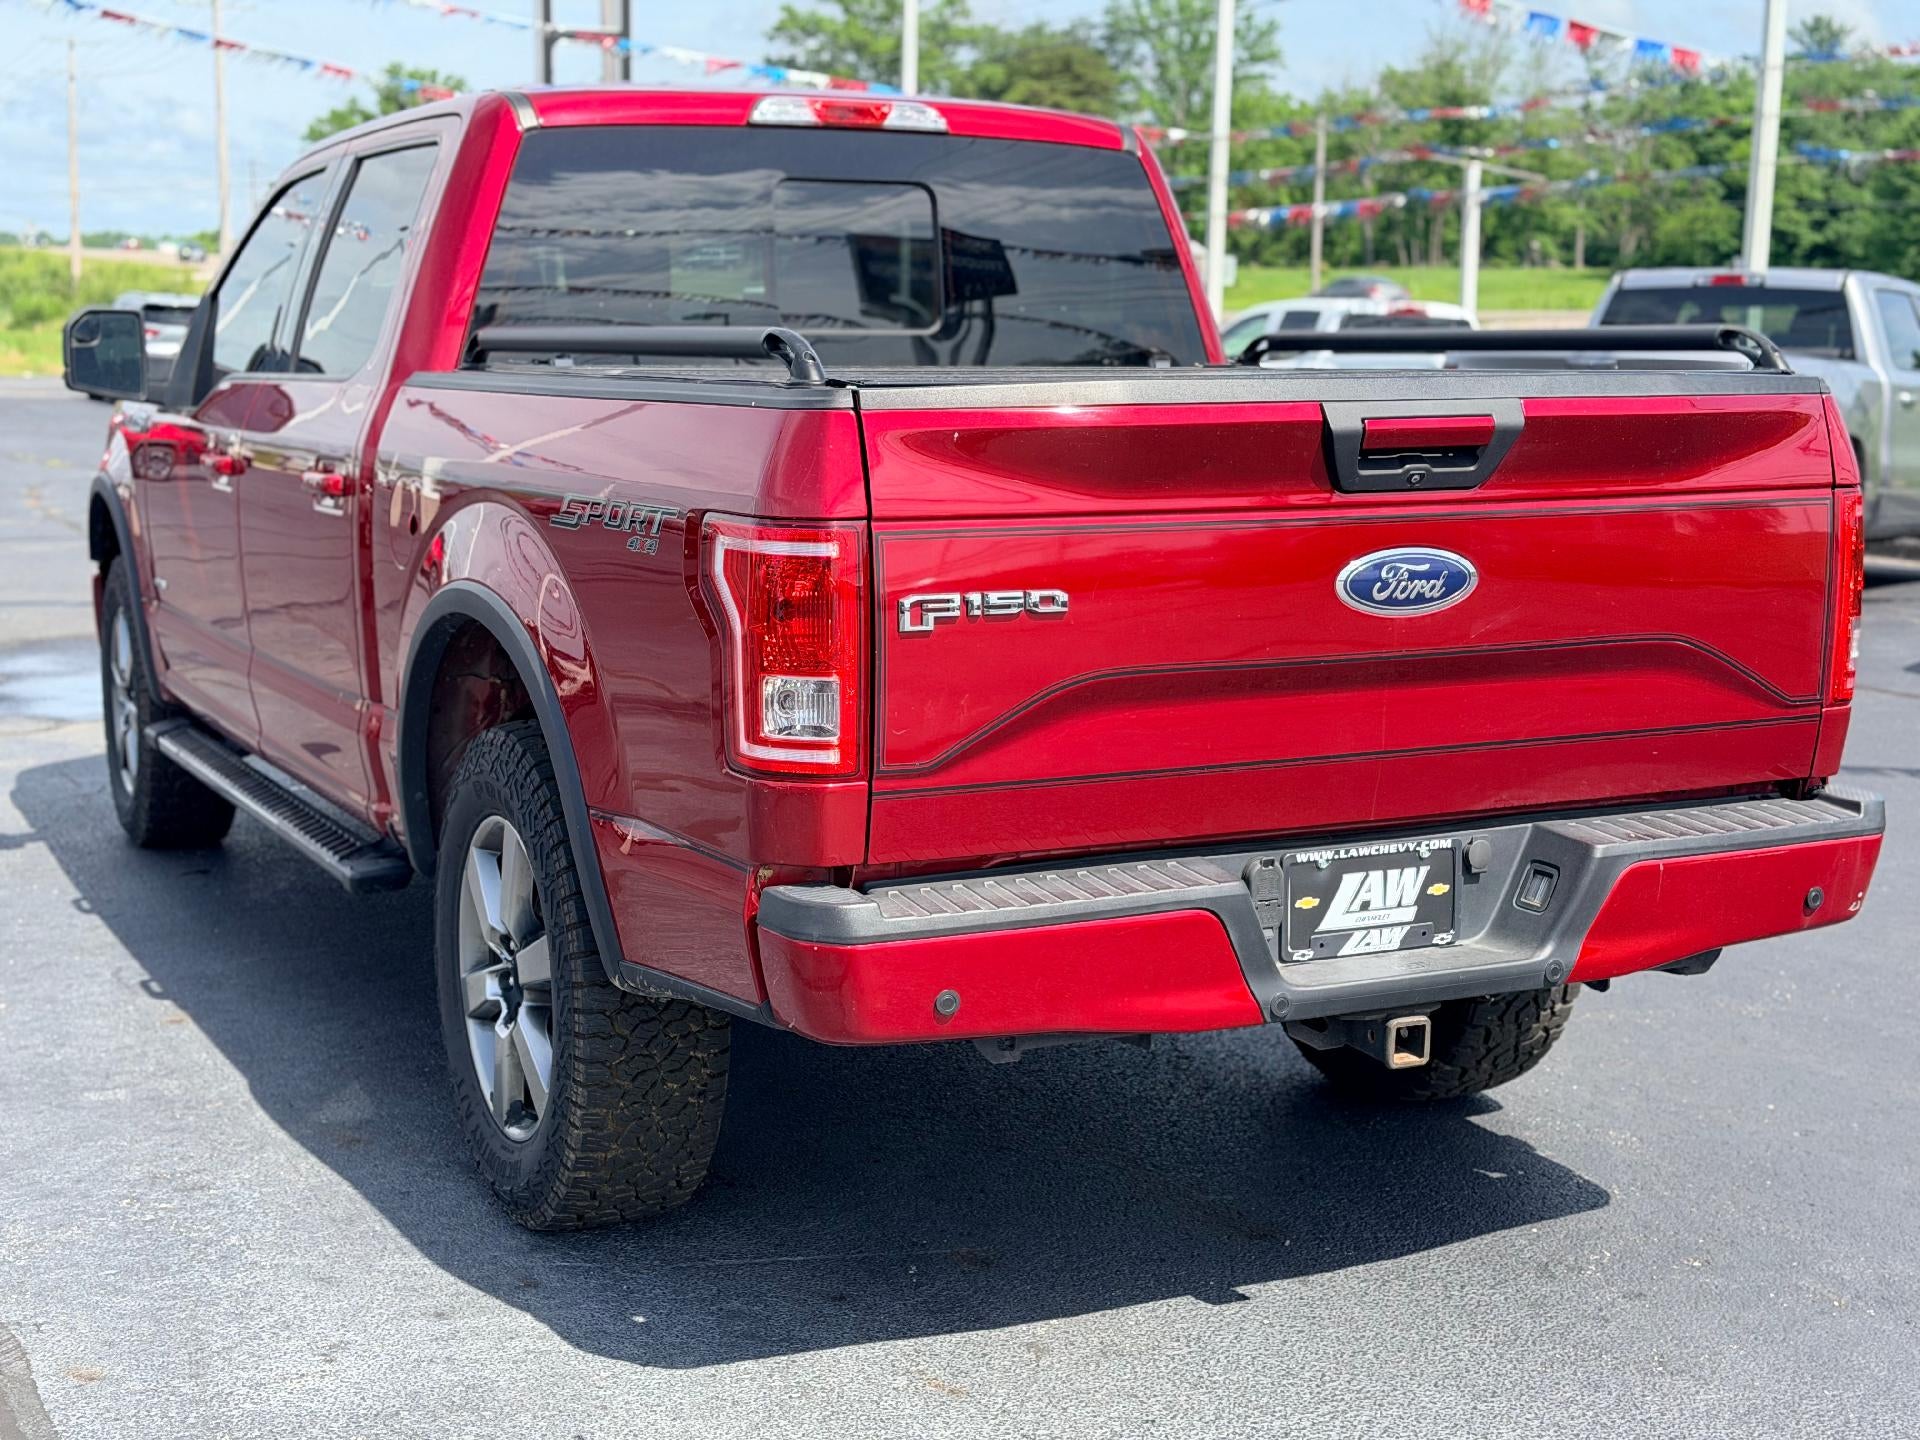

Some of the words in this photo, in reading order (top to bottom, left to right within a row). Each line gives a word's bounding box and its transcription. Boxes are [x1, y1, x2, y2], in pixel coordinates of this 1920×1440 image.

[550, 493, 680, 537] SPORT
[1372, 562, 1449, 601] Ford
[1296, 839, 1452, 863] WWW.LAWCHEVY.COM
[1315, 865, 1430, 932] LAW
[1337, 926, 1411, 956] LAW
